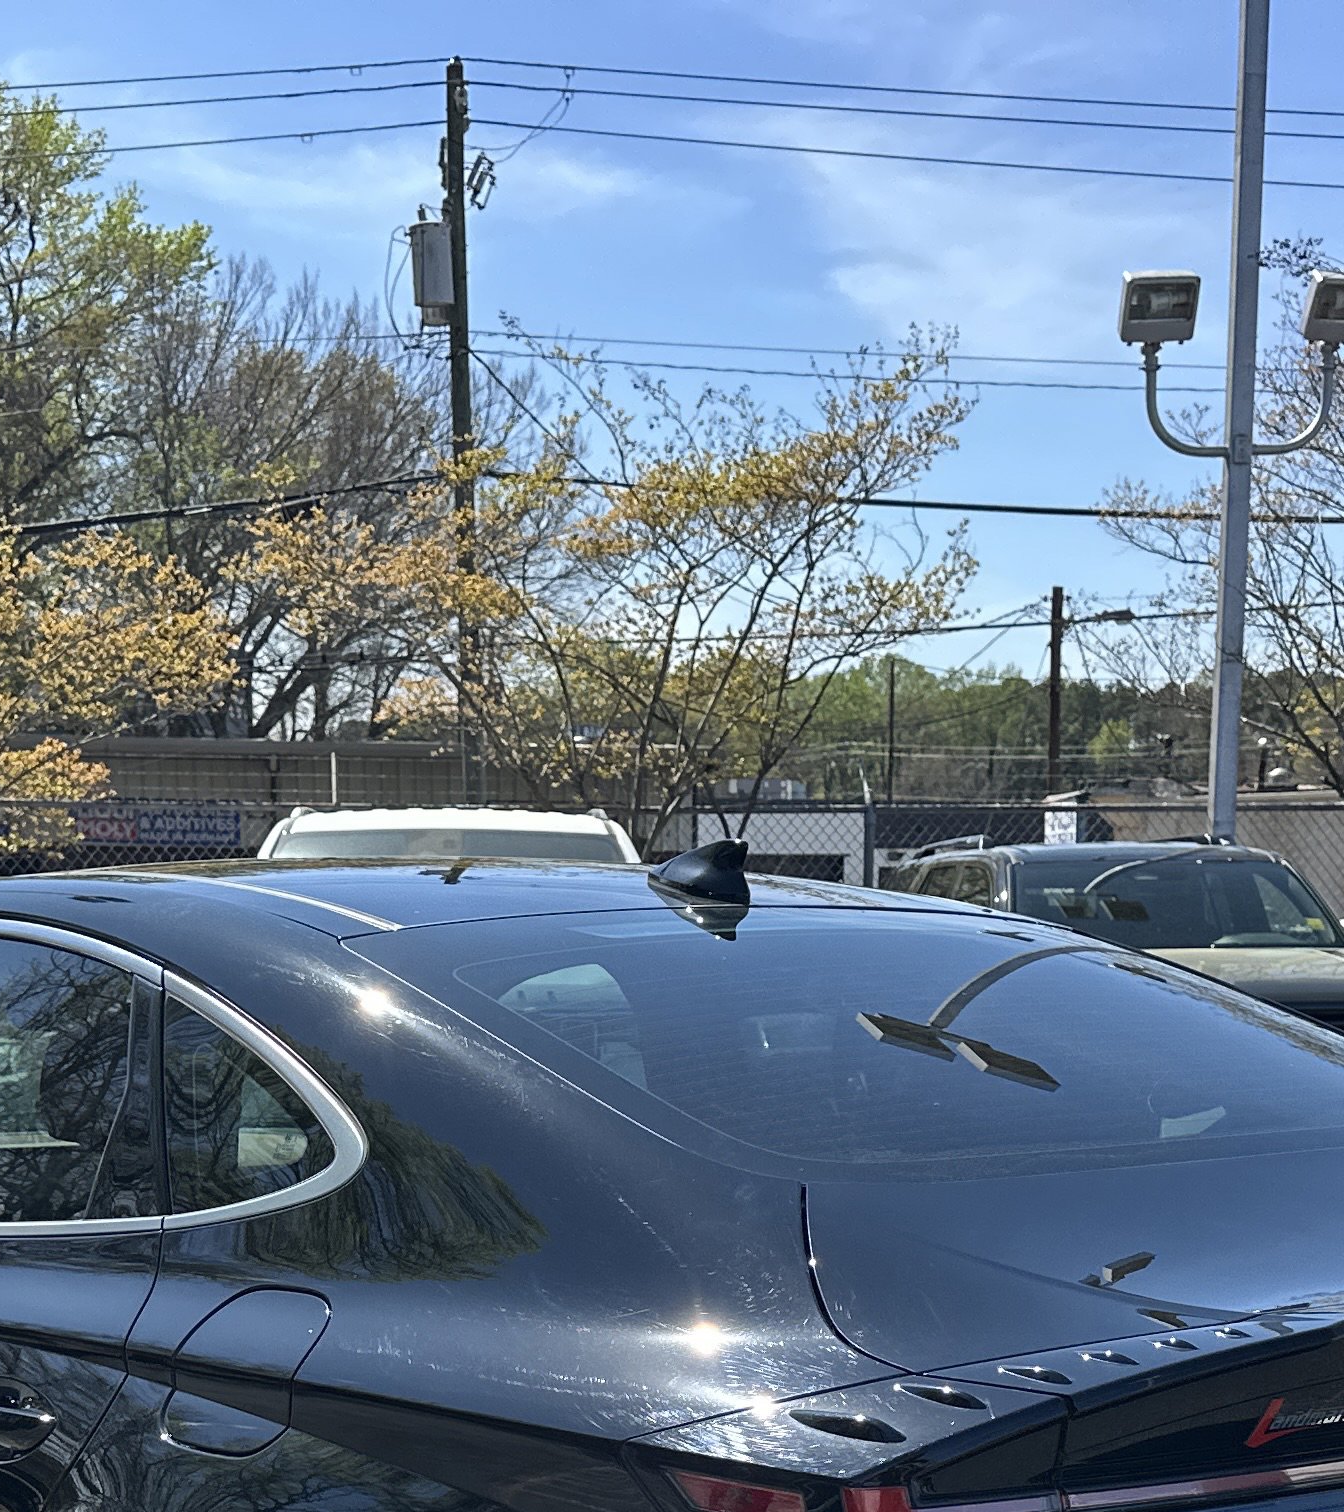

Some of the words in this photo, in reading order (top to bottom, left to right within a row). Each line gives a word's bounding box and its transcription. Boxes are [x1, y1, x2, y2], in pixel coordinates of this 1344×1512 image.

[77, 819, 135, 839] MOLY
[140, 816, 151, 830] &
[154, 816, 235, 830] ADDITIVES
